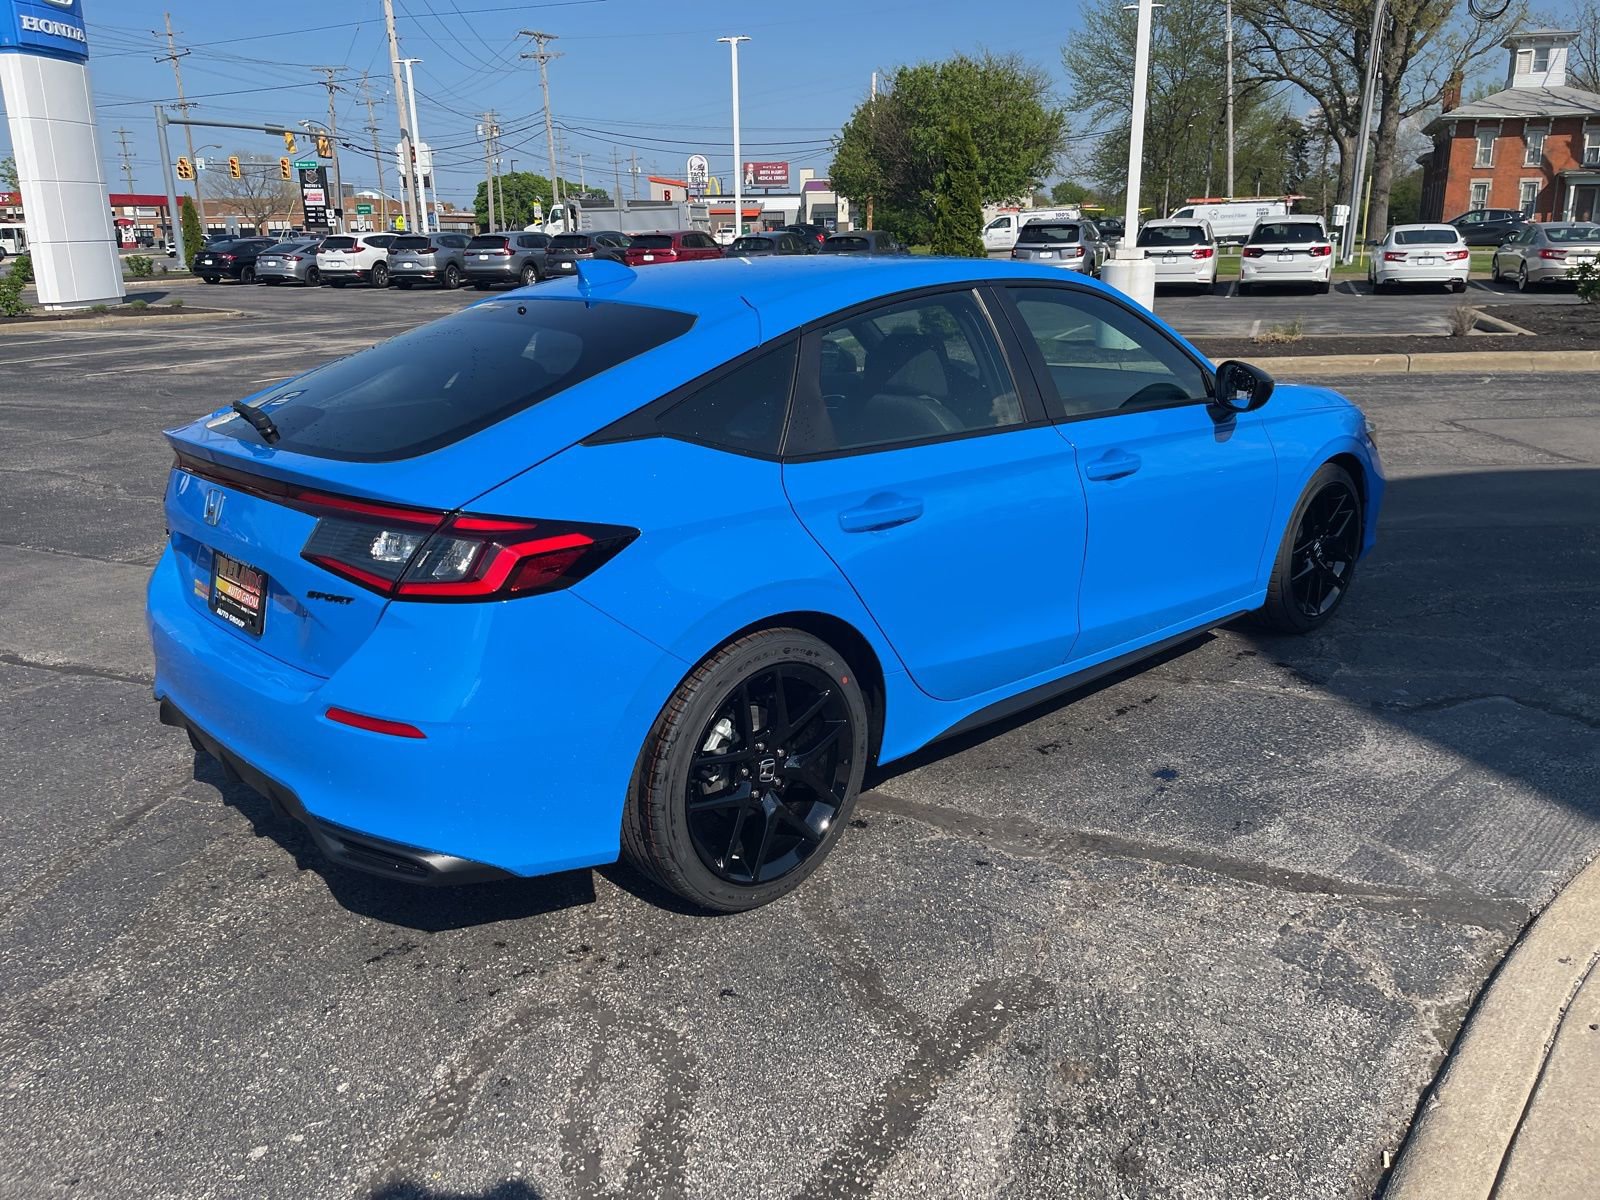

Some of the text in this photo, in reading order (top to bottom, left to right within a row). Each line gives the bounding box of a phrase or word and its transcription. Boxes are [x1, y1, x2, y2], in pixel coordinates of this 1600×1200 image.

[20, 15, 86, 42] HONDA
[227, 585, 242, 600] AUTO
[241, 593, 259, 608] GROU
[306, 590, 355, 605] SPORT
[216, 607, 246, 628] AUTO GROUP
